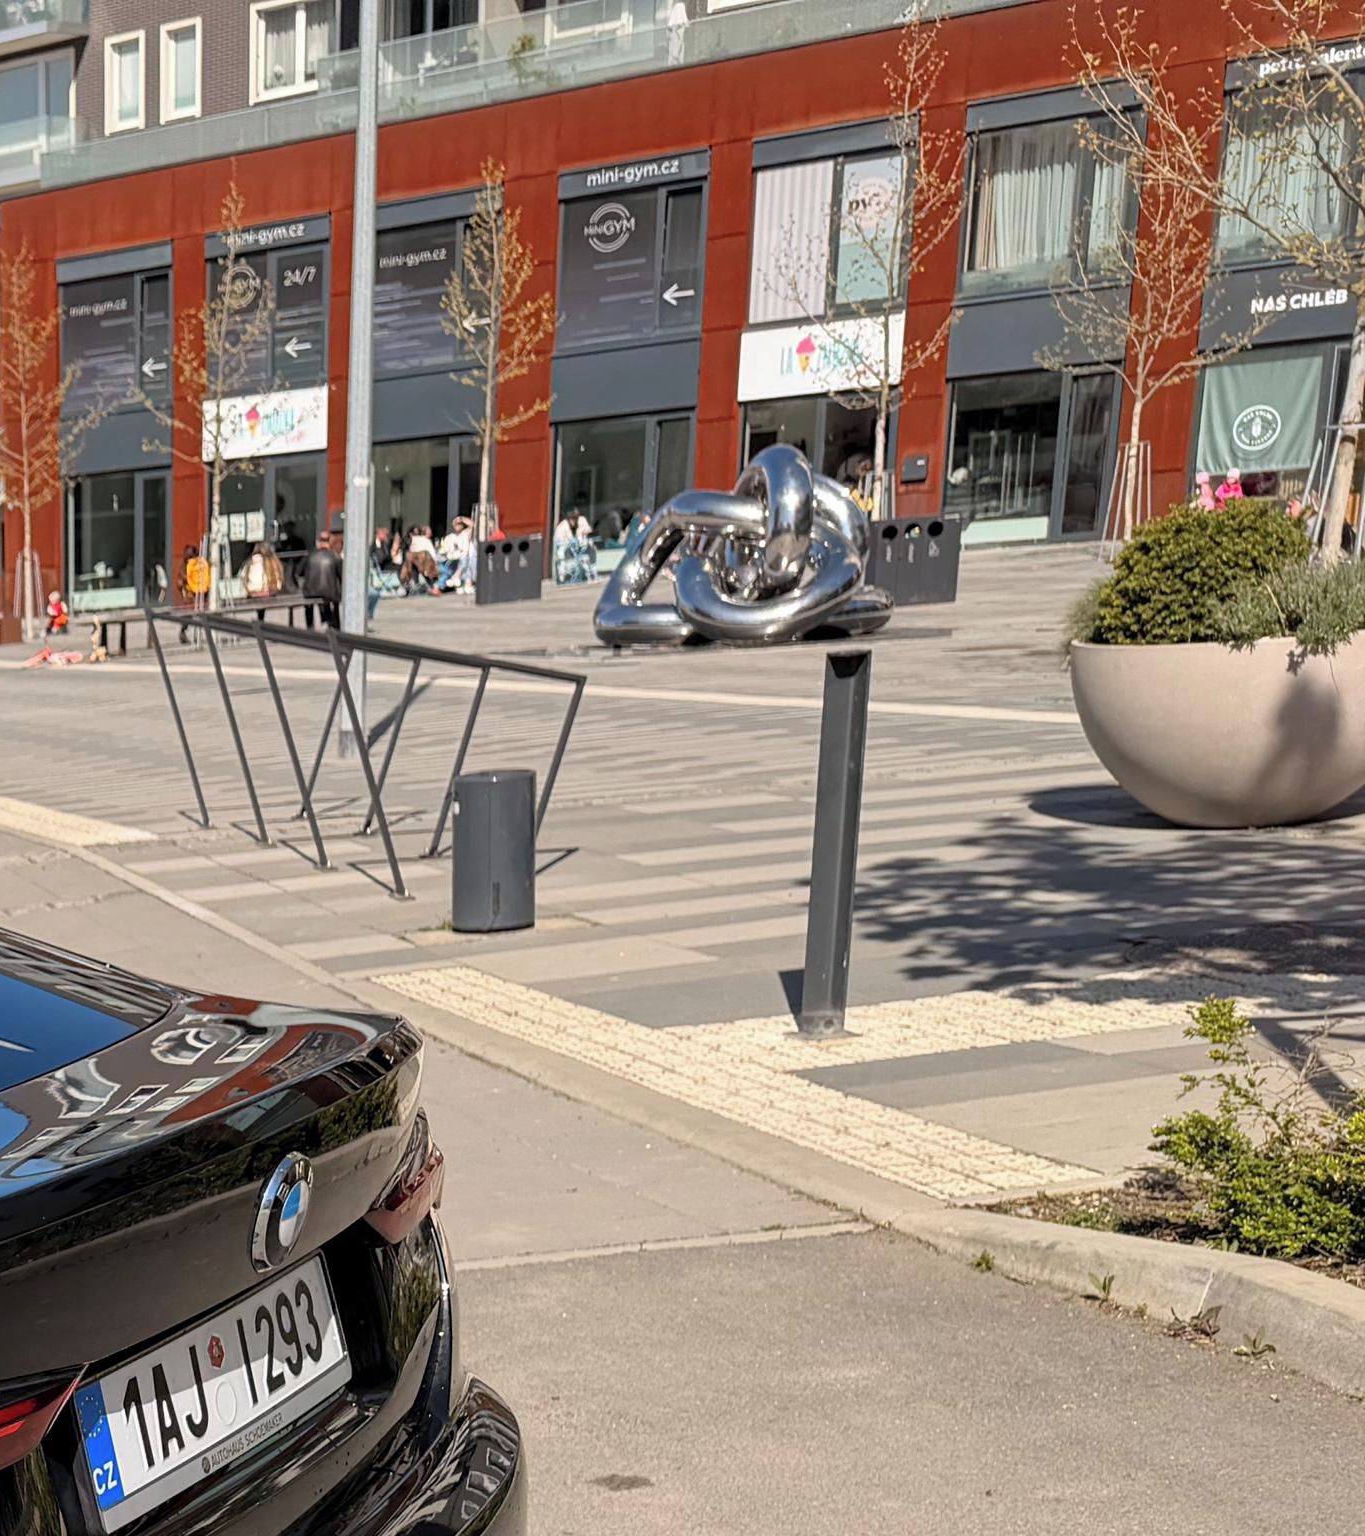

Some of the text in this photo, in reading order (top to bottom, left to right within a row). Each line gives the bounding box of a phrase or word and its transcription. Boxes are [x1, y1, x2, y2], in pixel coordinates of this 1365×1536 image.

[586, 159, 680, 187] mini-gym.cz
[283, 265, 317, 287] 24/7
[123, 1345, 209, 1468] 1AJ
[92, 1461, 118, 1496] CZ
